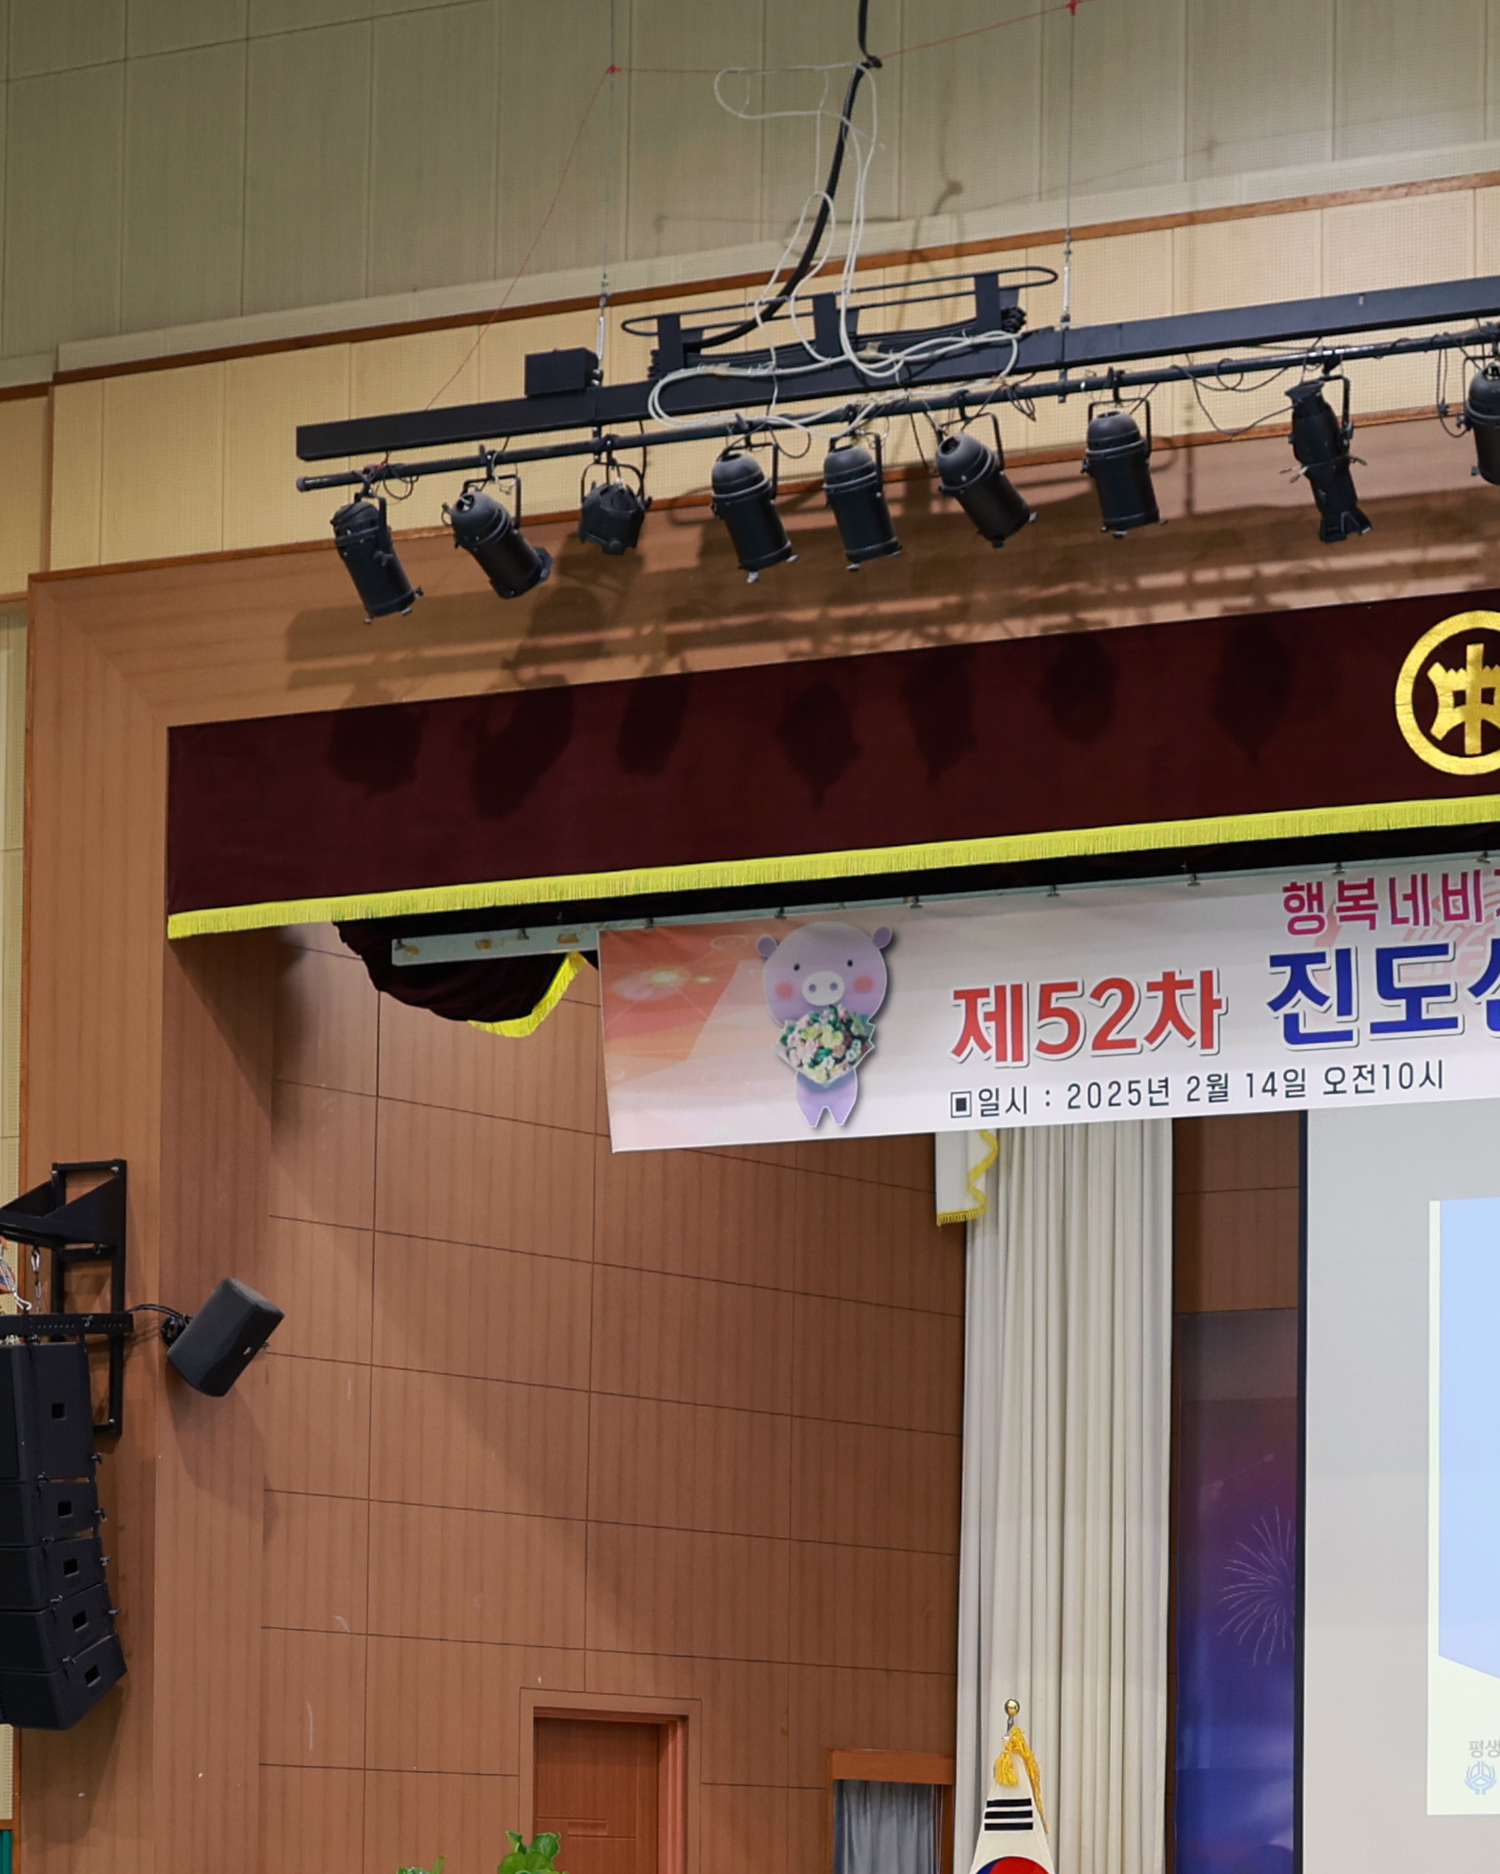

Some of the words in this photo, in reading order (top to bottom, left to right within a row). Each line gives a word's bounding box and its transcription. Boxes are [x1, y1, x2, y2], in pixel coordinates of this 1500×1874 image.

[950, 969, 1223, 1064] 제52차
[977, 1086, 1028, 1118] 일시
[1066, 1077, 1171, 1110] 2025년
[1186, 1072, 1230, 1104] 2월
[1246, 1067, 1307, 1099] 14일
[1322, 1059, 1443, 1096] 오전10시
